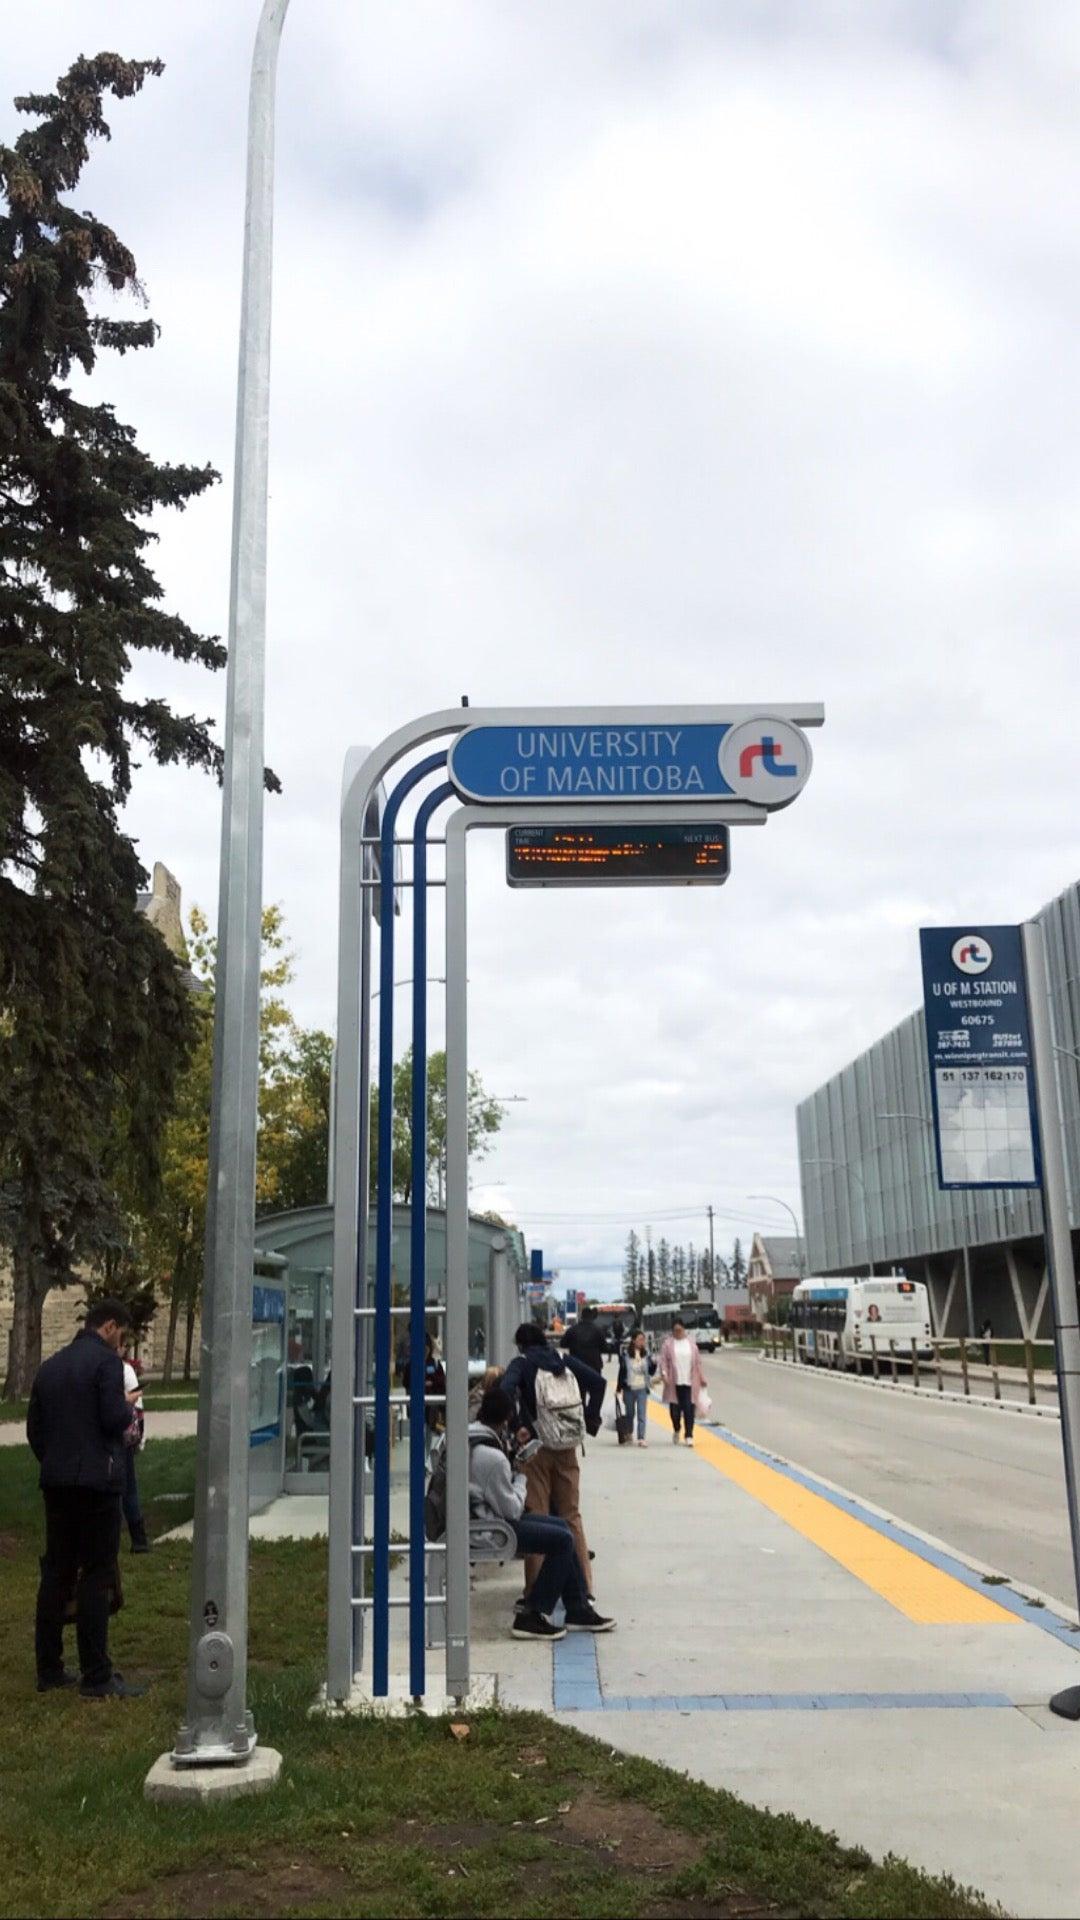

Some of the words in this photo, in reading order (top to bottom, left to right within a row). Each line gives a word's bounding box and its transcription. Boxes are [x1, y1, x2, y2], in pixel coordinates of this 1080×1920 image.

[517, 731, 682, 758] UNIVERSITY
[500, 767, 536, 792] OF
[547, 765, 705, 792] MANITOBA
[684, 835, 703, 843] NEXT
[705, 834, 720, 842] BUS
[932, 983, 941, 996] U
[943, 982, 957, 996] OF
[960, 982, 971, 995] M
[973, 981, 1017, 995] STATION
[950, 999, 1003, 1008] WESTBOUND
[961, 1015, 995, 1025] 60675
[942, 1072, 954, 1081] 51
[961, 1071, 980, 1080] 137
[982, 1071, 1003, 1080] 162
[1004, 1071, 1024, 1080] 170
